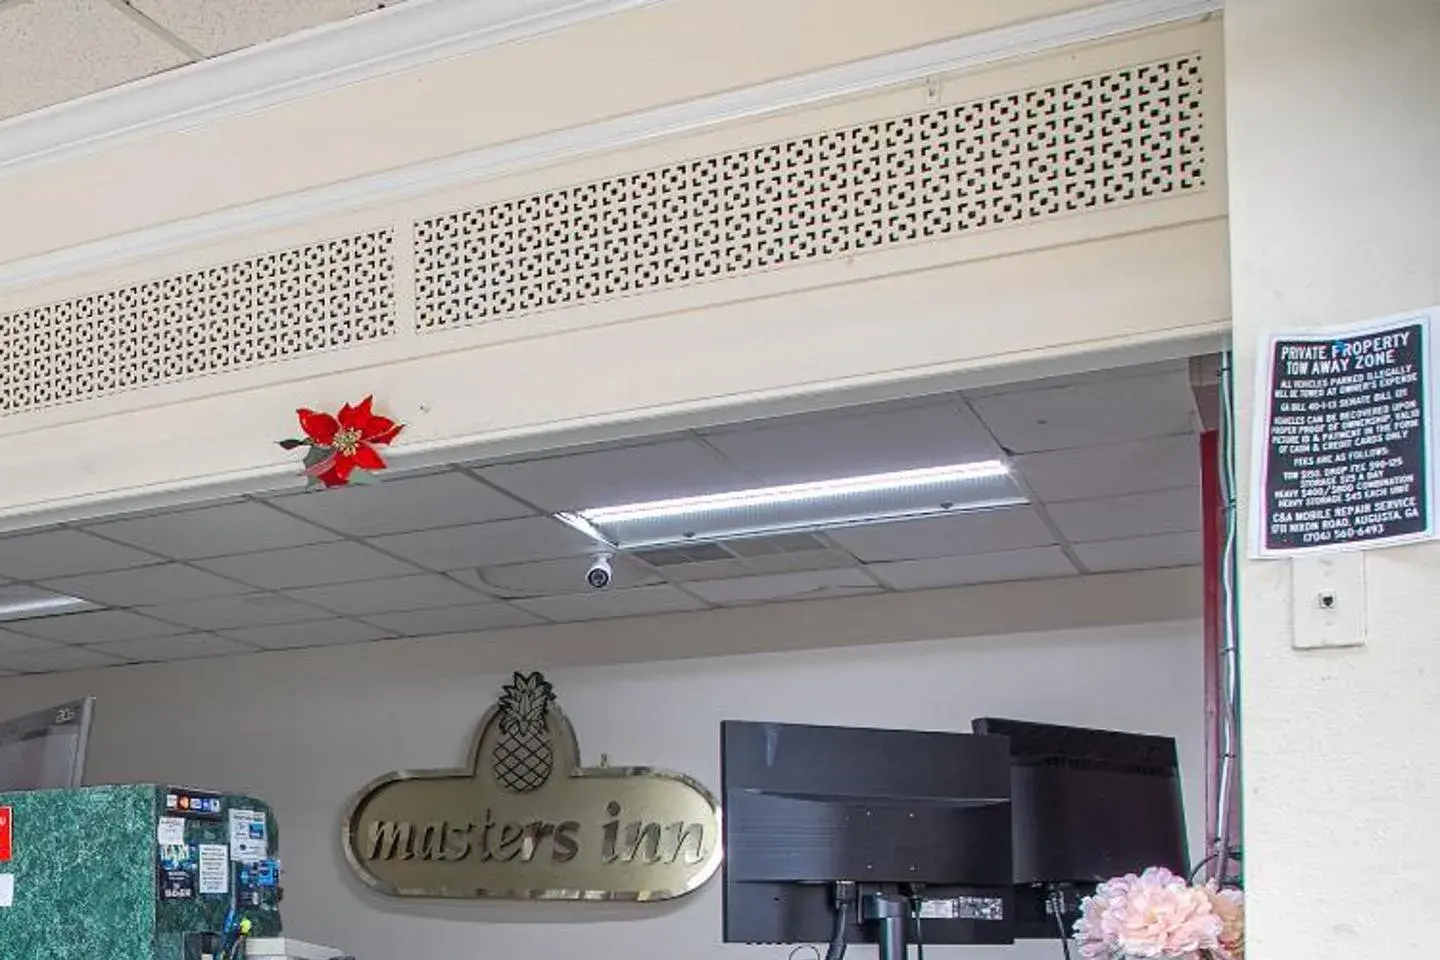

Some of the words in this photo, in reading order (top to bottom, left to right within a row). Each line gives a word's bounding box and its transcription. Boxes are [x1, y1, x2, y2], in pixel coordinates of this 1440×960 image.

[1281, 345, 1327, 360] PRIVATE
[1332, 332, 1410, 358] PROPERTY
[1286, 361, 1308, 375] TOW
[1311, 358, 1349, 375] AWAY
[1355, 349, 1397, 369] ZONE
[1294, 378, 1328, 389] VEHICLES
[1330, 374, 1364, 385] PARKED
[1366, 364, 1412, 380] ILLEGALLY
[1327, 387, 1337, 396] AT
[1379, 372, 1418, 387] EXPENSE
[1307, 415, 1323, 424] CAN
[1339, 405, 1390, 420] RECOVERED
[1391, 399, 1417, 412] UPON
[1322, 429, 1361, 441] PAYMENT
[1376, 423, 1391, 434] THE
[1394, 419, 1419, 430] FORM
[1327, 422, 1338, 432] OF
[1322, 440, 1352, 451] CREDIT
[1354, 434, 1383, 446] CARDS
[1385, 430, 1408, 441] ONLY
[1335, 452, 1346, 462] AS
[1366, 470, 1384, 480] DAY
[1295, 508, 1332, 521] MOBILE
[1334, 503, 1372, 518] REPAIR
[1374, 496, 1417, 512] SERVICE
[1404, 507, 1419, 518] GA
[368, 807, 581, 864] masters
[602, 800, 704, 865] inn
